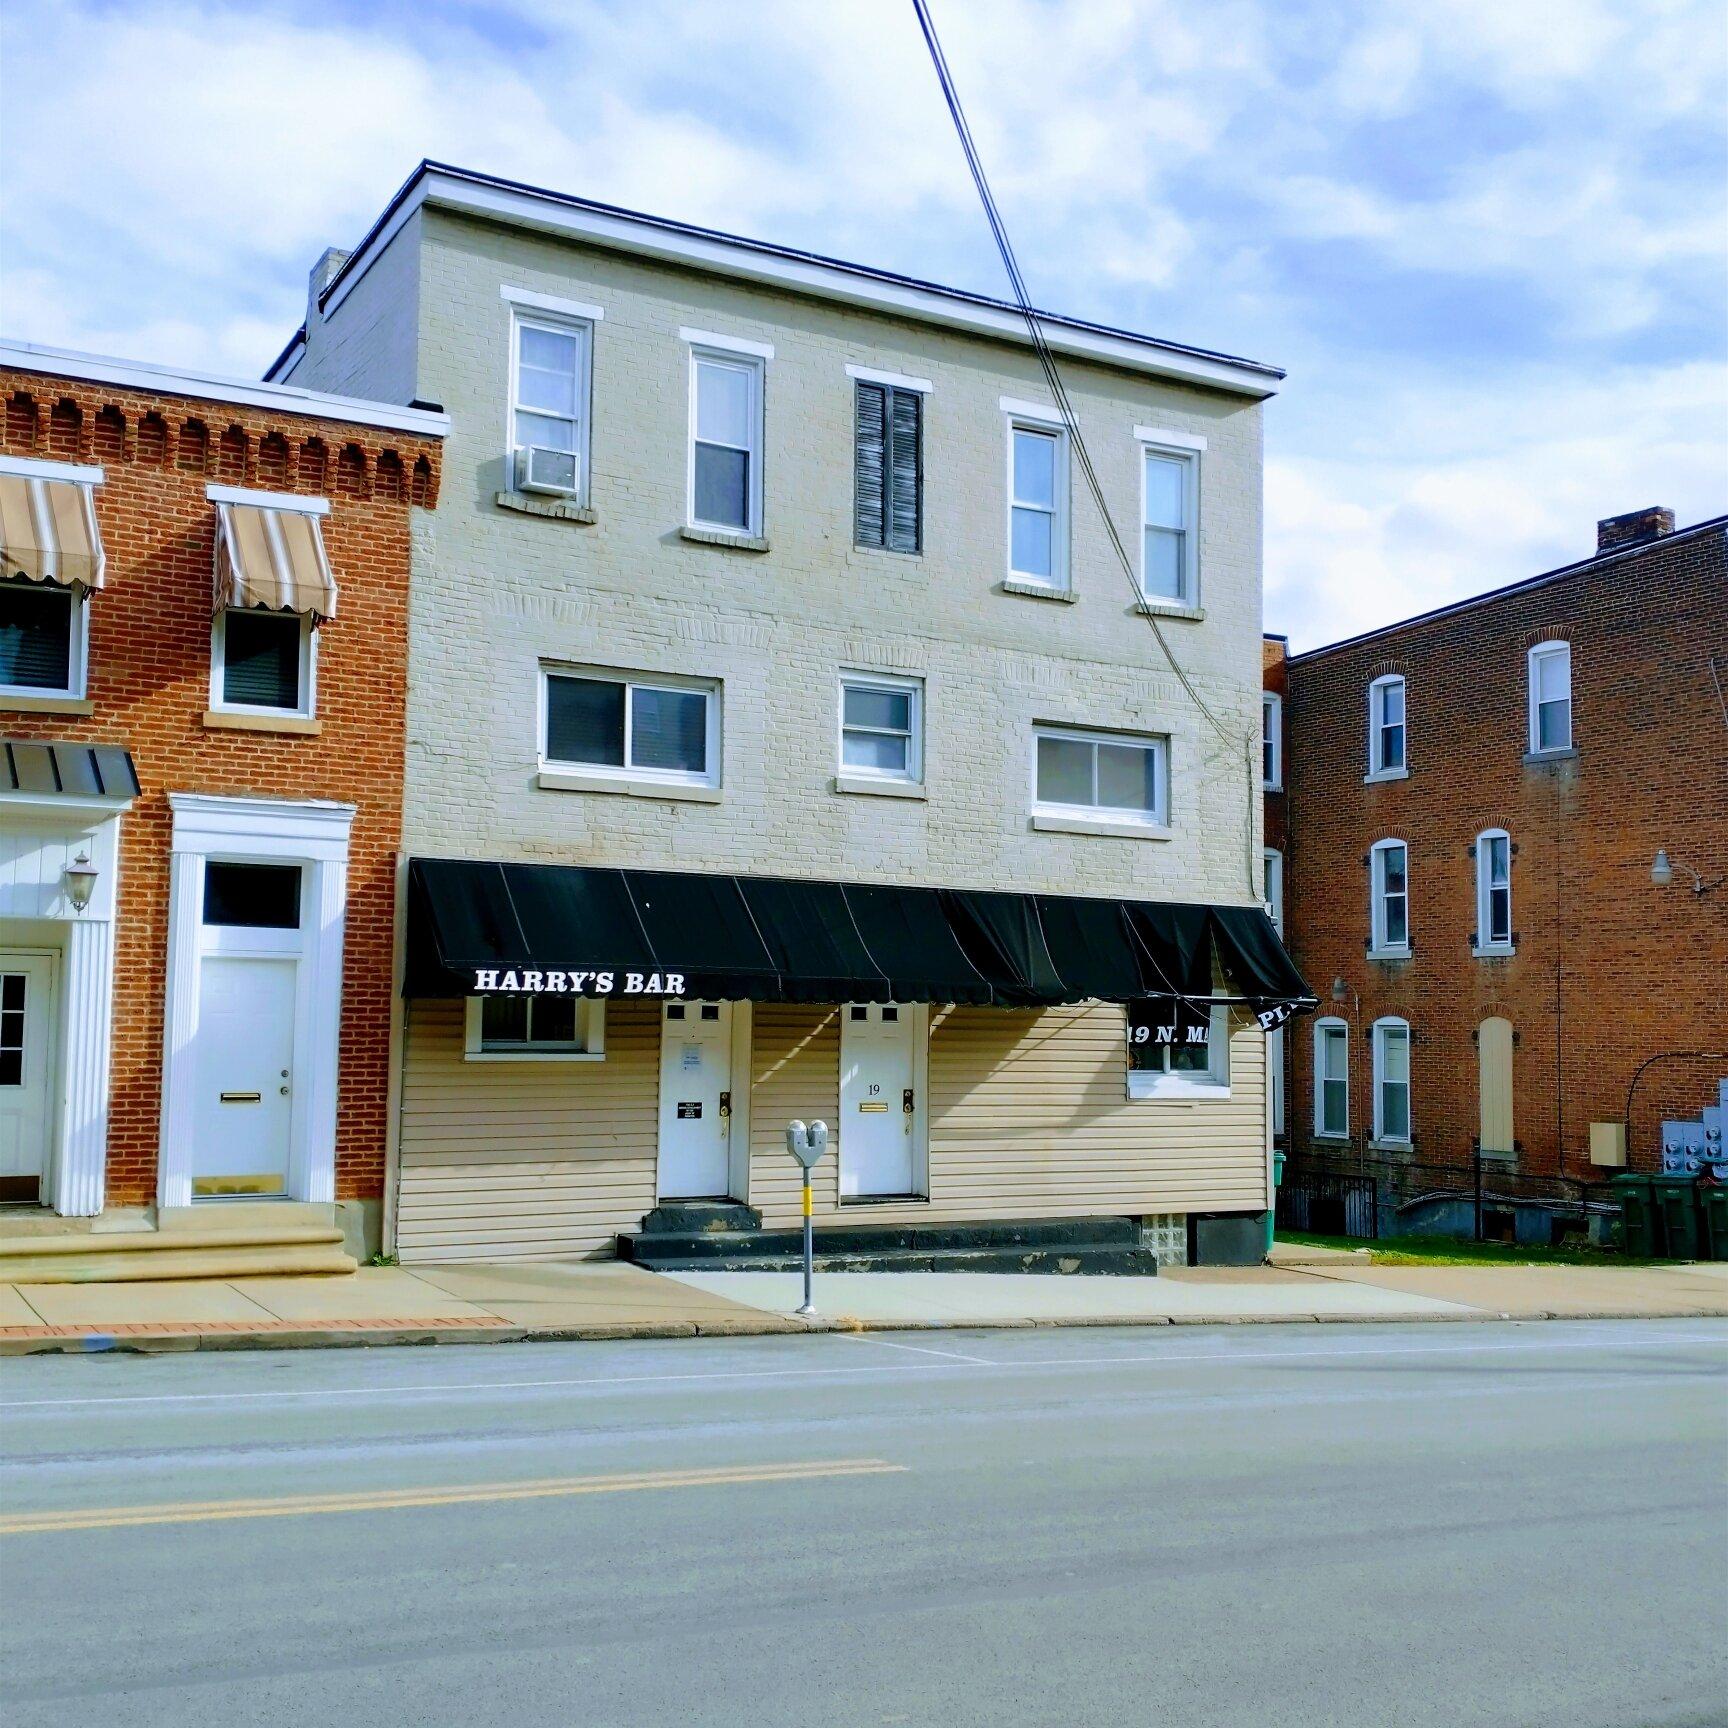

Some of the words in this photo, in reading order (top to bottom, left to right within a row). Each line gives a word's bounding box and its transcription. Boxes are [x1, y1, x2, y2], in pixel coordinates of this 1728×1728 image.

[474, 969, 614, 994] HARRY'S
[623, 972, 686, 995] BAR
[1154, 1025, 1178, 1043] N.
[869, 1084, 880, 1096] 19
